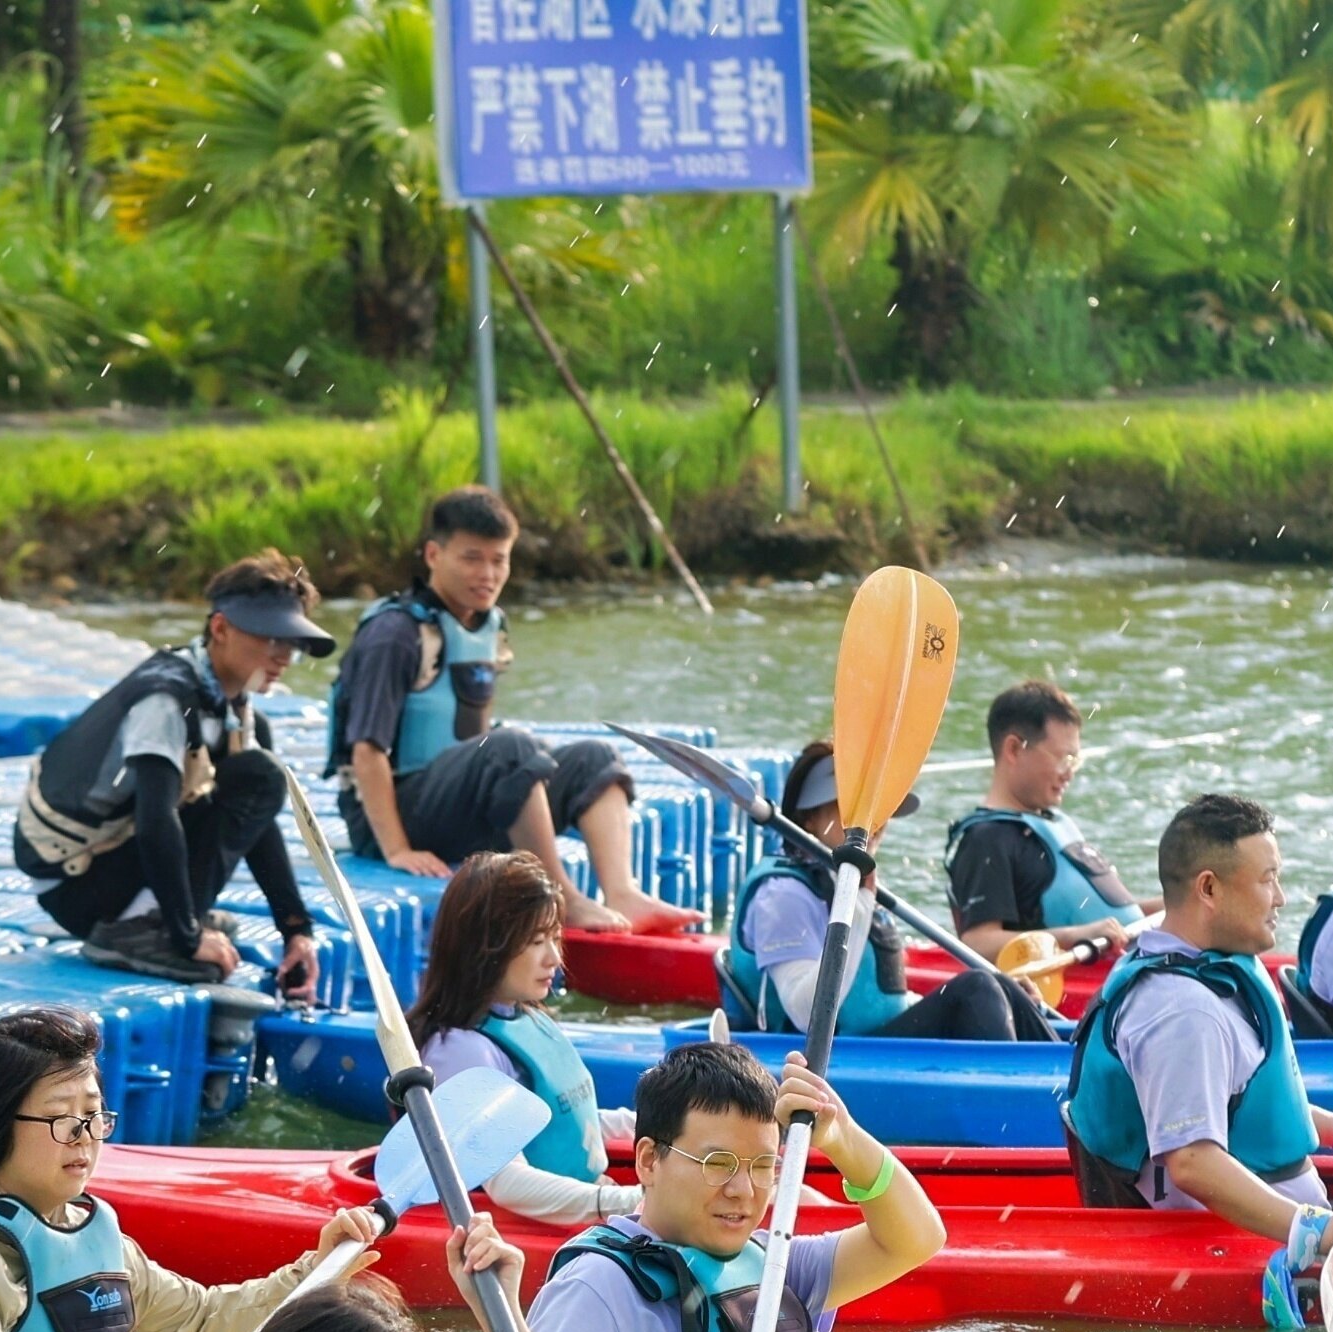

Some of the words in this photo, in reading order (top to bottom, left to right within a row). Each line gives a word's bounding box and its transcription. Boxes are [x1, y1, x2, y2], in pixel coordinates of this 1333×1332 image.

[470, 62, 619, 154] 严禁下湖
[635, 57, 787, 151] 禁止垂钓
